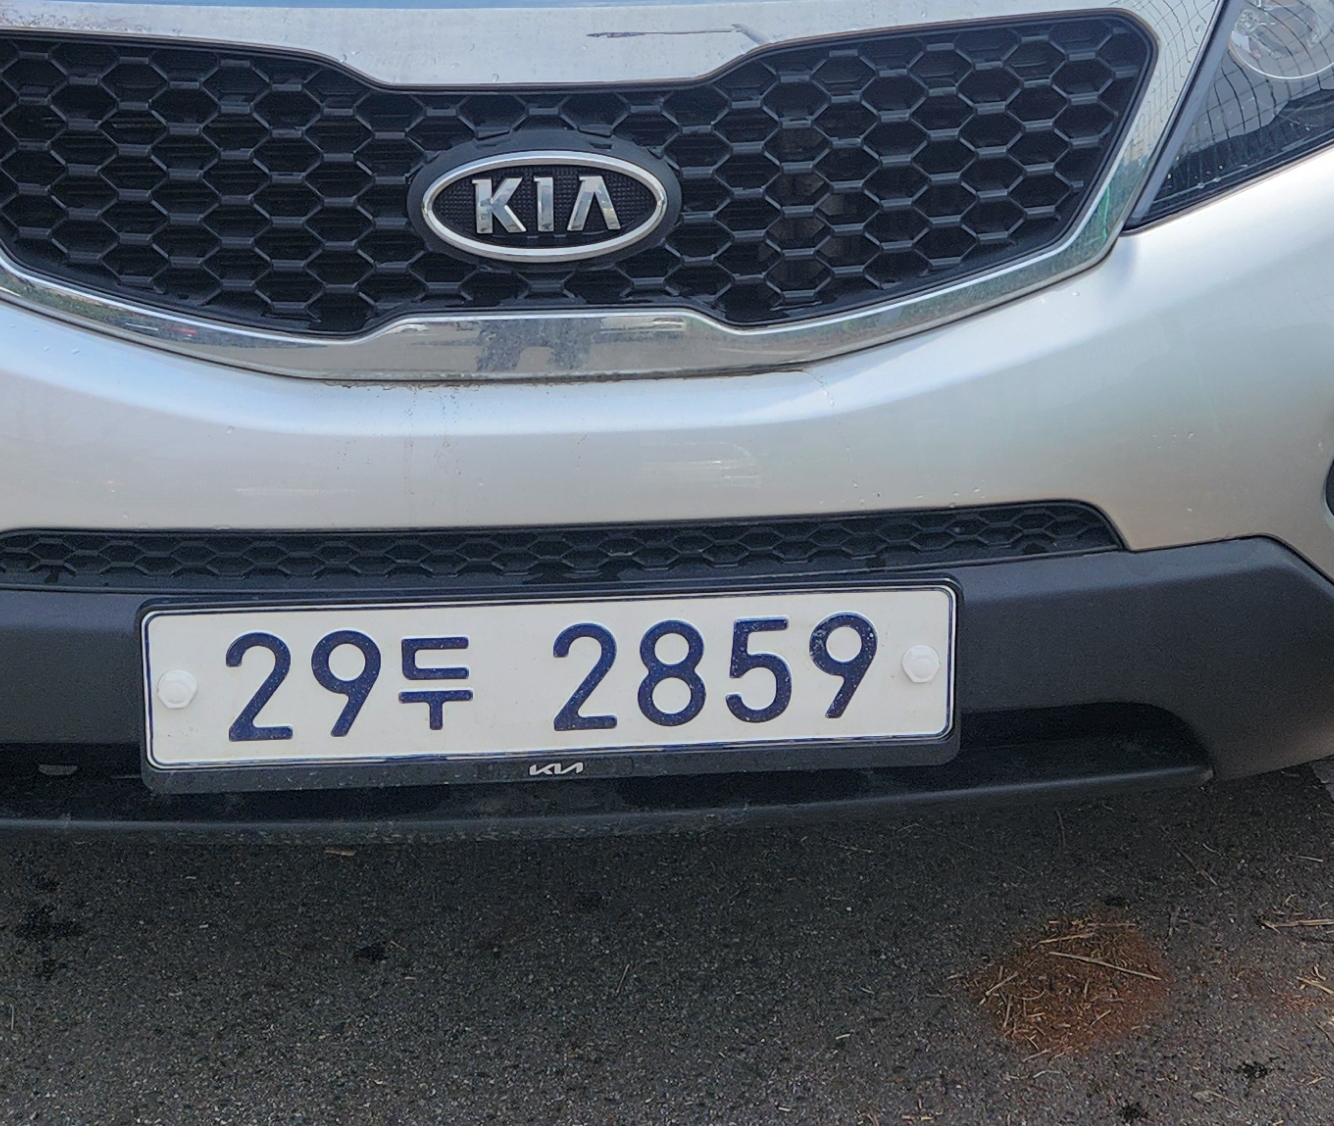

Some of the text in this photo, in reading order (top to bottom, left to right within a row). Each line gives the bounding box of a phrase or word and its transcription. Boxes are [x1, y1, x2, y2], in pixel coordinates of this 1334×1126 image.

[472, 176, 621, 234] KIA
[225, 612, 878, 742] 29두 2859
